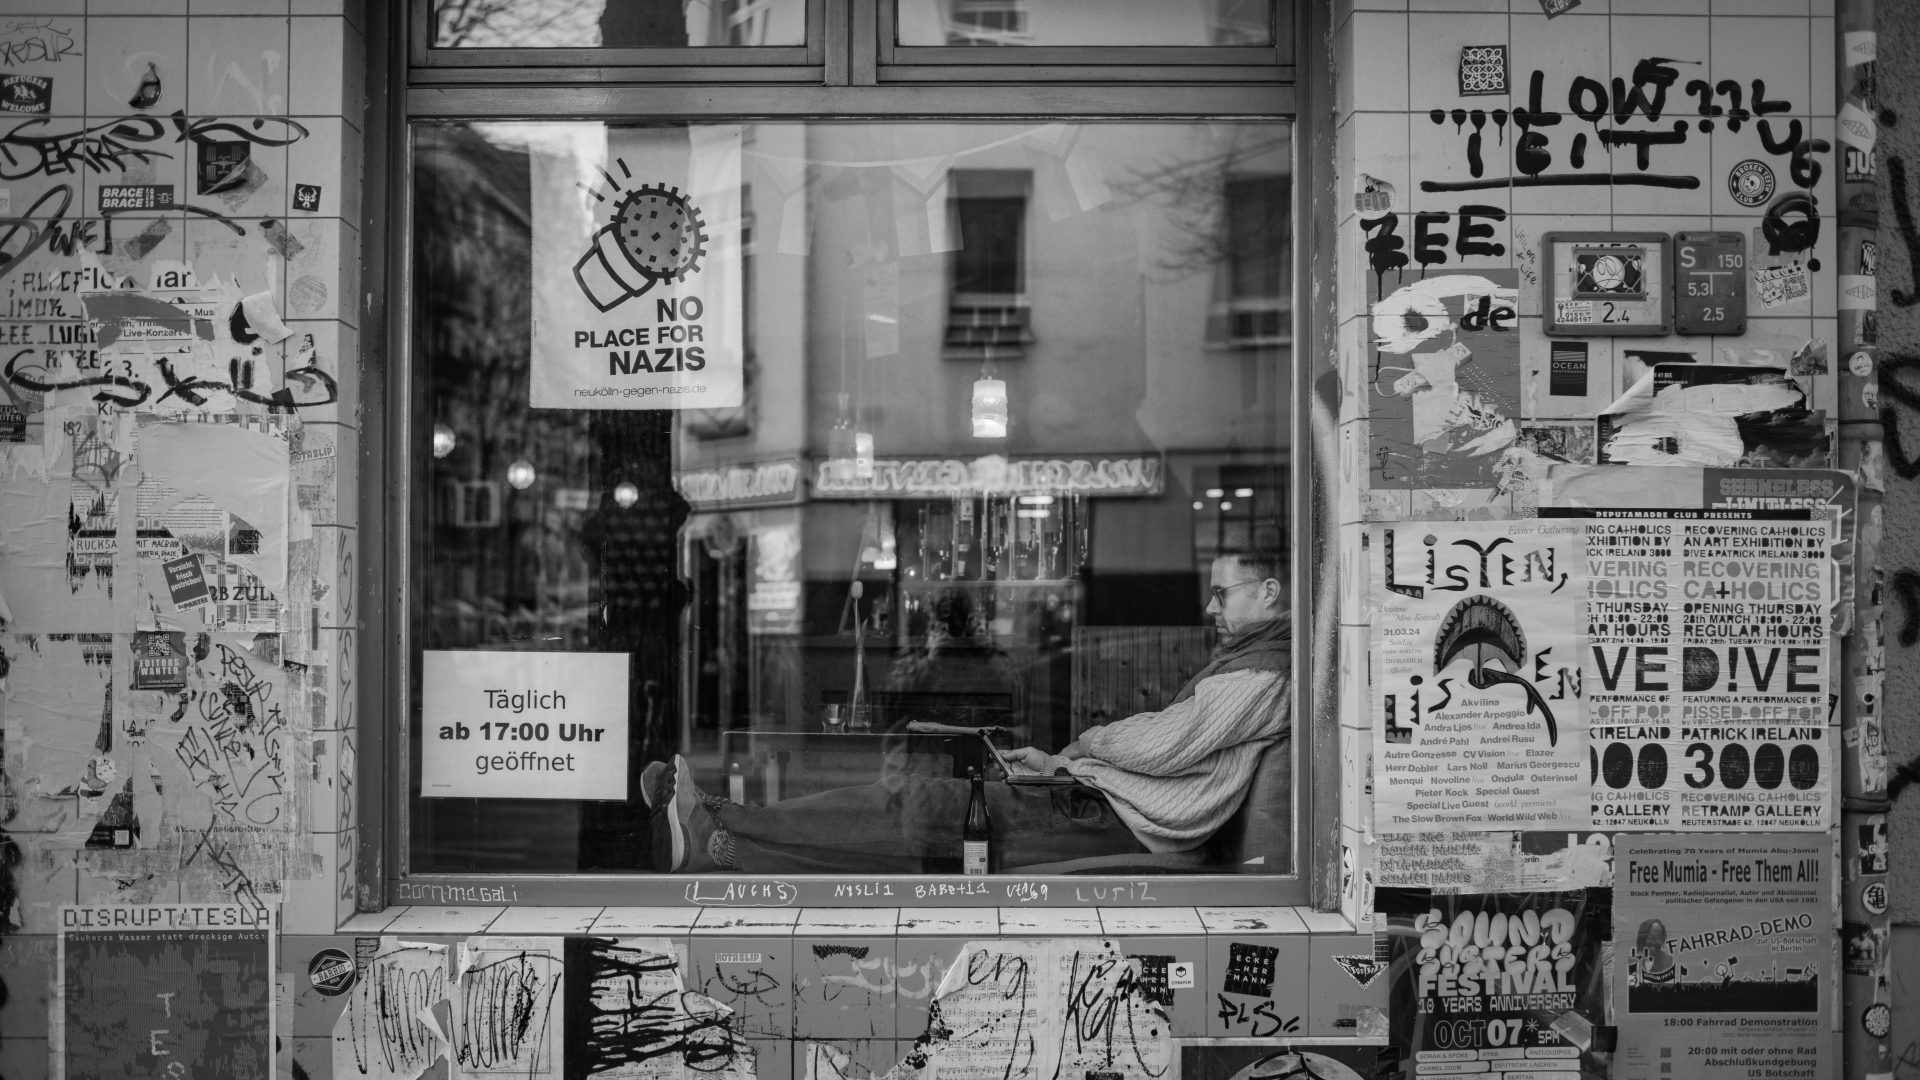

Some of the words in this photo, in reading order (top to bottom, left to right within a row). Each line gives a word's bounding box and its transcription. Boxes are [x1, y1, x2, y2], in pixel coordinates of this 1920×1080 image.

[3, 75, 48, 90] REFUGEES
[1, 100, 46, 112] WELCOME
[1735, 164, 1764, 176] BROKEN
[103, 188, 144, 198] BRACE
[1736, 191, 1753, 203] CLUB
[103, 198, 144, 208] BRACE
[1680, 246, 1696, 268] S
[1718, 254, 1743, 268] 150
[1688, 282, 1709, 296] 5,3
[657, 296, 703, 322] NO
[1703, 307, 1724, 321] 2,5
[575, 328, 650, 348] PLACE
[657, 325, 704, 344] FOR
[609, 347, 706, 375] NAZIS
[1553, 362, 1586, 370] OCEAN
[574, 385, 707, 398] neukölln-gegen-nazis.de
[1685, 526, 1757, 536] RECOVERING
[1684, 537, 1700, 546] AN
[1704, 537, 1729, 547] ART
[1733, 538, 1802, 547] EXHIBITION
[1807, 538, 1824, 548] BY
[1715, 550, 1755, 558] PATRICK
[1684, 561, 1820, 579] RECOVERING
[1684, 603, 1744, 614] OPENING
[1749, 604, 1821, 614] THURSDAY
[1710, 615, 1750, 624] MARCH
[1384, 628, 1420, 636] 31.03.24
[1683, 625, 1760, 637] REGULAR
[1767, 625, 1823, 638] HOURS
[140, 659, 179, 668] EDITORS
[484, 689, 566, 713] Täglich
[1461, 699, 1500, 707] Akvilina
[1435, 712, 1482, 721] Alexander
[1483, 710, 1525, 720] Arpeggio
[1683, 706, 1783, 719] PISSED-OFF
[439, 722, 470, 740] ab
[479, 722, 549, 741] 17:00
[559, 723, 605, 742] Uhr
[1424, 724, 1452, 732] Andra
[1453, 723, 1472, 732] Ljos
[1493, 722, 1525, 730] Andrea
[1527, 722, 1541, 730] Ida
[1682, 728, 1747, 740] PATRICK
[1751, 728, 1821, 740] IRELAND
[1420, 737, 1448, 746] André
[1449, 737, 1469, 746] Pahl
[1480, 736, 1510, 744] Andrei
[1512, 735, 1535, 743] Rusu
[1384, 751, 1410, 759] Autre
[1412, 751, 1456, 759] Gonzesse
[1478, 750, 1505, 758] Vision
[1526, 749, 1554, 757] Elazer
[475, 751, 575, 775] geöffnet
[1386, 764, 1407, 772] Herr
[1408, 764, 1439, 772] Dobler
[1447, 763, 1467, 772] Lars
[1470, 762, 1488, 771] Noll
[1497, 762, 1528, 770] Marius
[1529, 761, 1580, 770] Georgescu
[1684, 743, 1820, 790] 3000
[1390, 777, 1423, 786] Menqui
[1431, 776, 1470, 784] Novoline
[1491, 774, 1524, 783] Ondula
[1531, 774, 1578, 782] Osterinsel
[1415, 789, 1442, 797] Pieter
[1445, 788, 1469, 797] Kock
[1475, 787, 1510, 796] Special
[1512, 787, 1540, 796] Guest
[1406, 802, 1440, 811] Special
[1441, 801, 1461, 810] Live
[1462, 800, 1489, 809] Guest
[1682, 805, 1750, 816] RETRAMP
[1755, 805, 1821, 817] GALLERY
[1392, 815, 1410, 823] The
[1411, 815, 1434, 823] Slow
[1435, 814, 1465, 823] Brown
[1466, 814, 1482, 822] Fox
[1488, 813, 1515, 822] World
[1516, 813, 1536, 821] Wild
[1537, 812, 1558, 821] Web
[1630, 861, 1658, 883] Free
[1663, 859, 1707, 883] Mumia
[1722, 860, 1751, 882] Free
[1755, 859, 1792, 882] Them
[1797, 859, 1819, 882] All!
[1683, 890, 1738, 898] Radiojournalist,
[1415, 908, 1575, 949] SOUND
[1666, 913, 1812, 954] FAHRRAD-DEMO
[68, 934, 113, 942] Sauberes
[119, 934, 152, 942] Wasser
[157, 933, 184, 941] statt
[189, 932, 233, 942] dreckige
[1771, 937, 1817, 945] US-Botschaft
[1237, 955, 1269, 965] ECKE
[318, 964, 346, 981] BARRIO
[1234, 975, 1266, 984] MANN
[1418, 970, 1576, 997] FESTIVAL
[1419, 998, 1434, 1014] 10
[1443, 997, 1482, 1013] YEARS
[1490, 994, 1577, 1011] ANNIVERSARY
[1663, 1018, 1693, 1026] 18:00
[1697, 1018, 1737, 1026] Fahrrad
[1741, 1018, 1818, 1026] Demonstration
[1434, 1020, 1486, 1048] OCT
[1487, 1019, 1523, 1047] 07
[1688, 1047, 1717, 1055] 20:00
[1741, 1047, 1765, 1055] oder
[1705, 1058, 1817, 1069] Abschlußkundgebung
[1748, 1069, 1762, 1078] US
[1765, 1069, 1815, 1078] Botschaft
